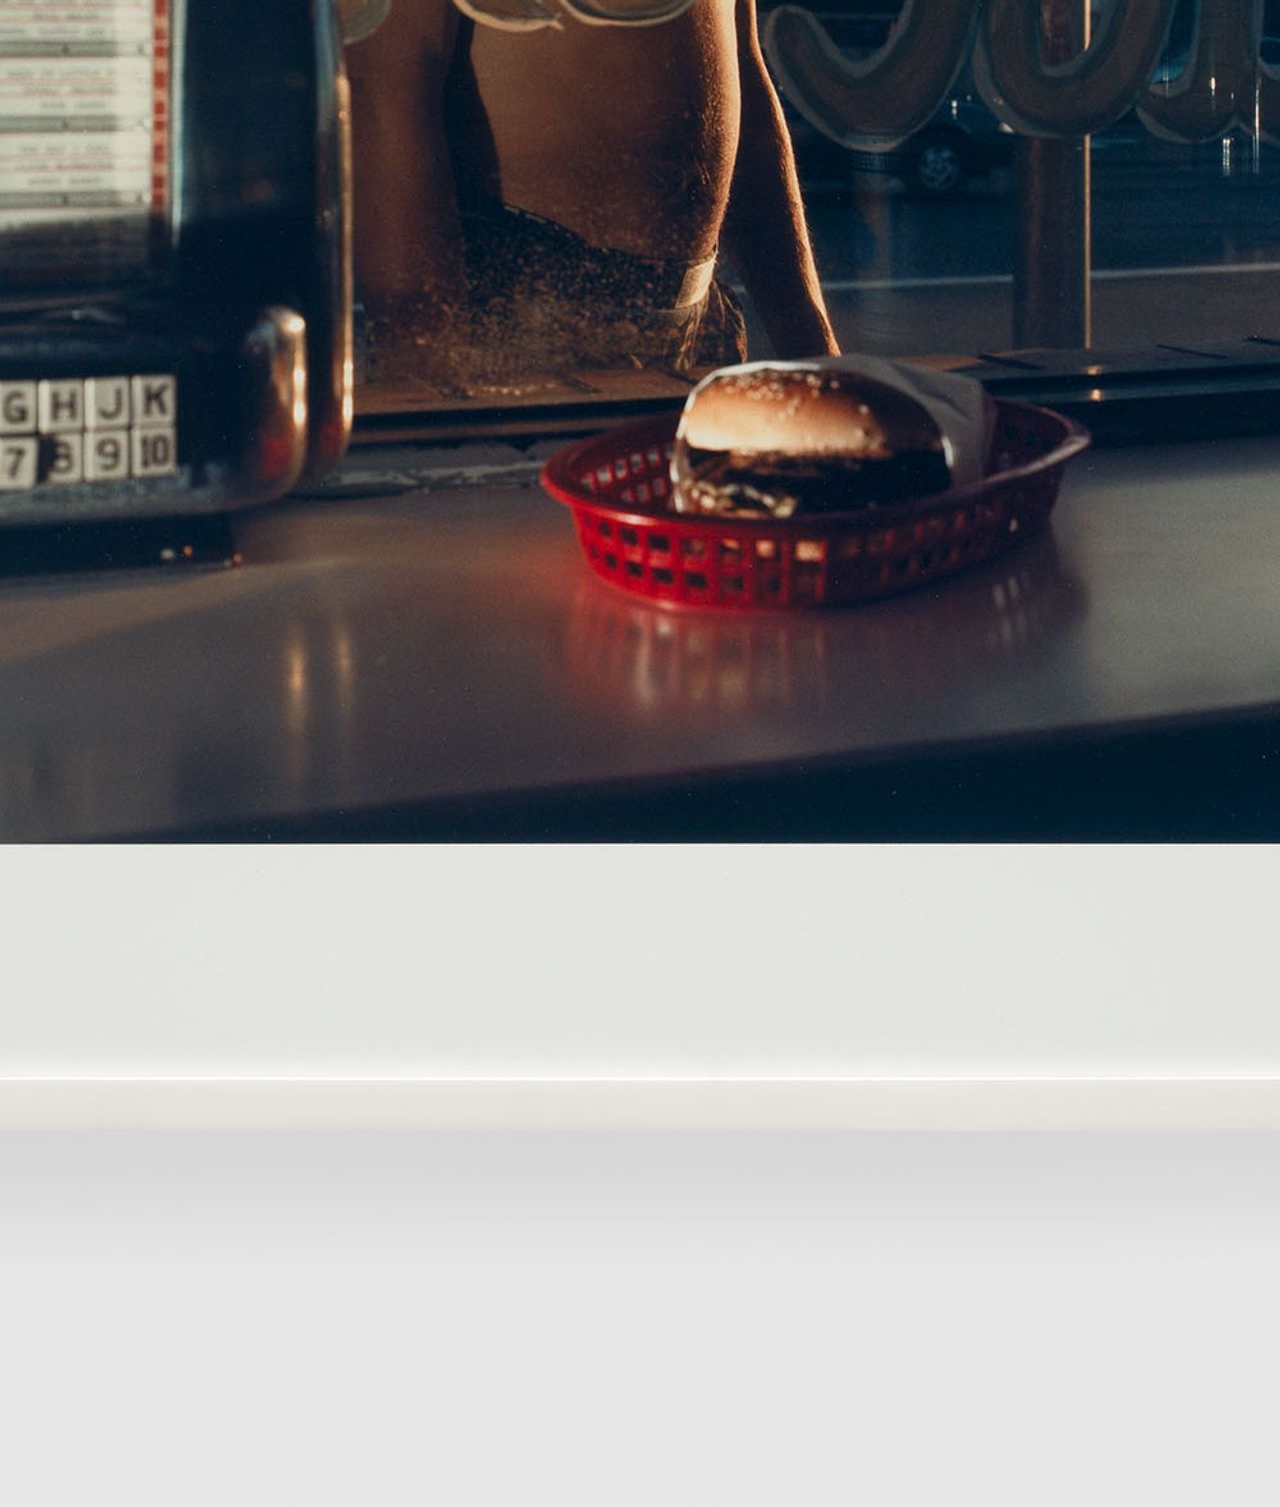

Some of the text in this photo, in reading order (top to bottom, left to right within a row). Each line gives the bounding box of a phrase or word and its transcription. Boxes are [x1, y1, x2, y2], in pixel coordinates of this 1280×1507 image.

[3, 393, 29, 425] G
[52, 389, 77, 422] H
[100, 387, 121, 420] J
[143, 385, 169, 417] K
[3, 446, 27, 479] 7
[54, 442, 74, 474] 8
[96, 438, 119, 470] 9
[142, 435, 169, 468] 10
